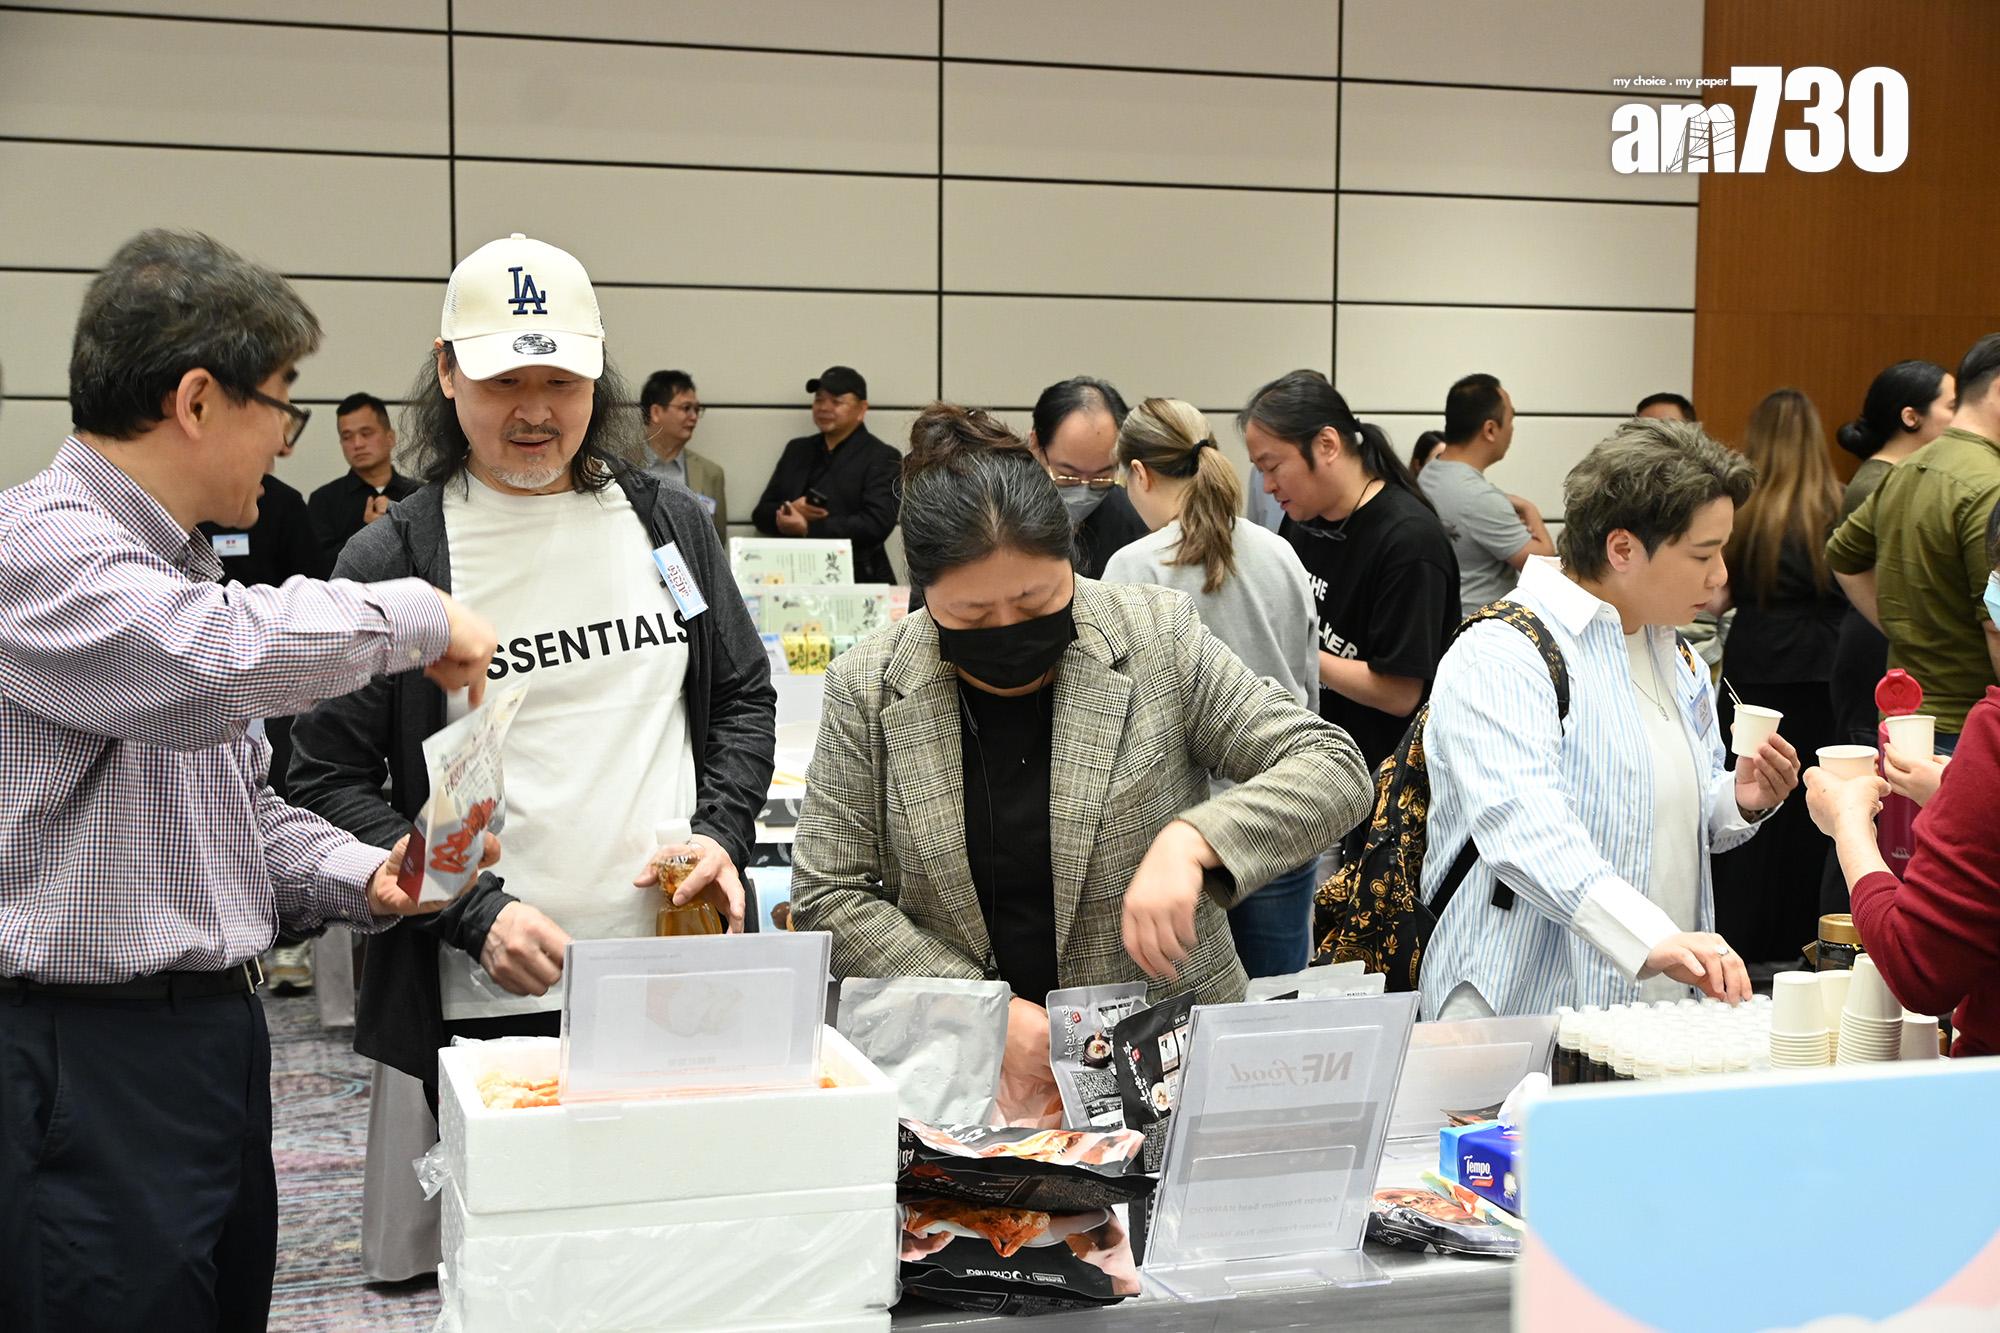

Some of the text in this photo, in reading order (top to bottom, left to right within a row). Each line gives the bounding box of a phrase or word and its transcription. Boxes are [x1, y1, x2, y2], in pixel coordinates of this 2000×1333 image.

[508, 266, 548, 315] LA
[1307, 573, 1329, 601] HE
[486, 609, 690, 680] SSENTIALS
[1463, 1155, 1491, 1176] Tempo
